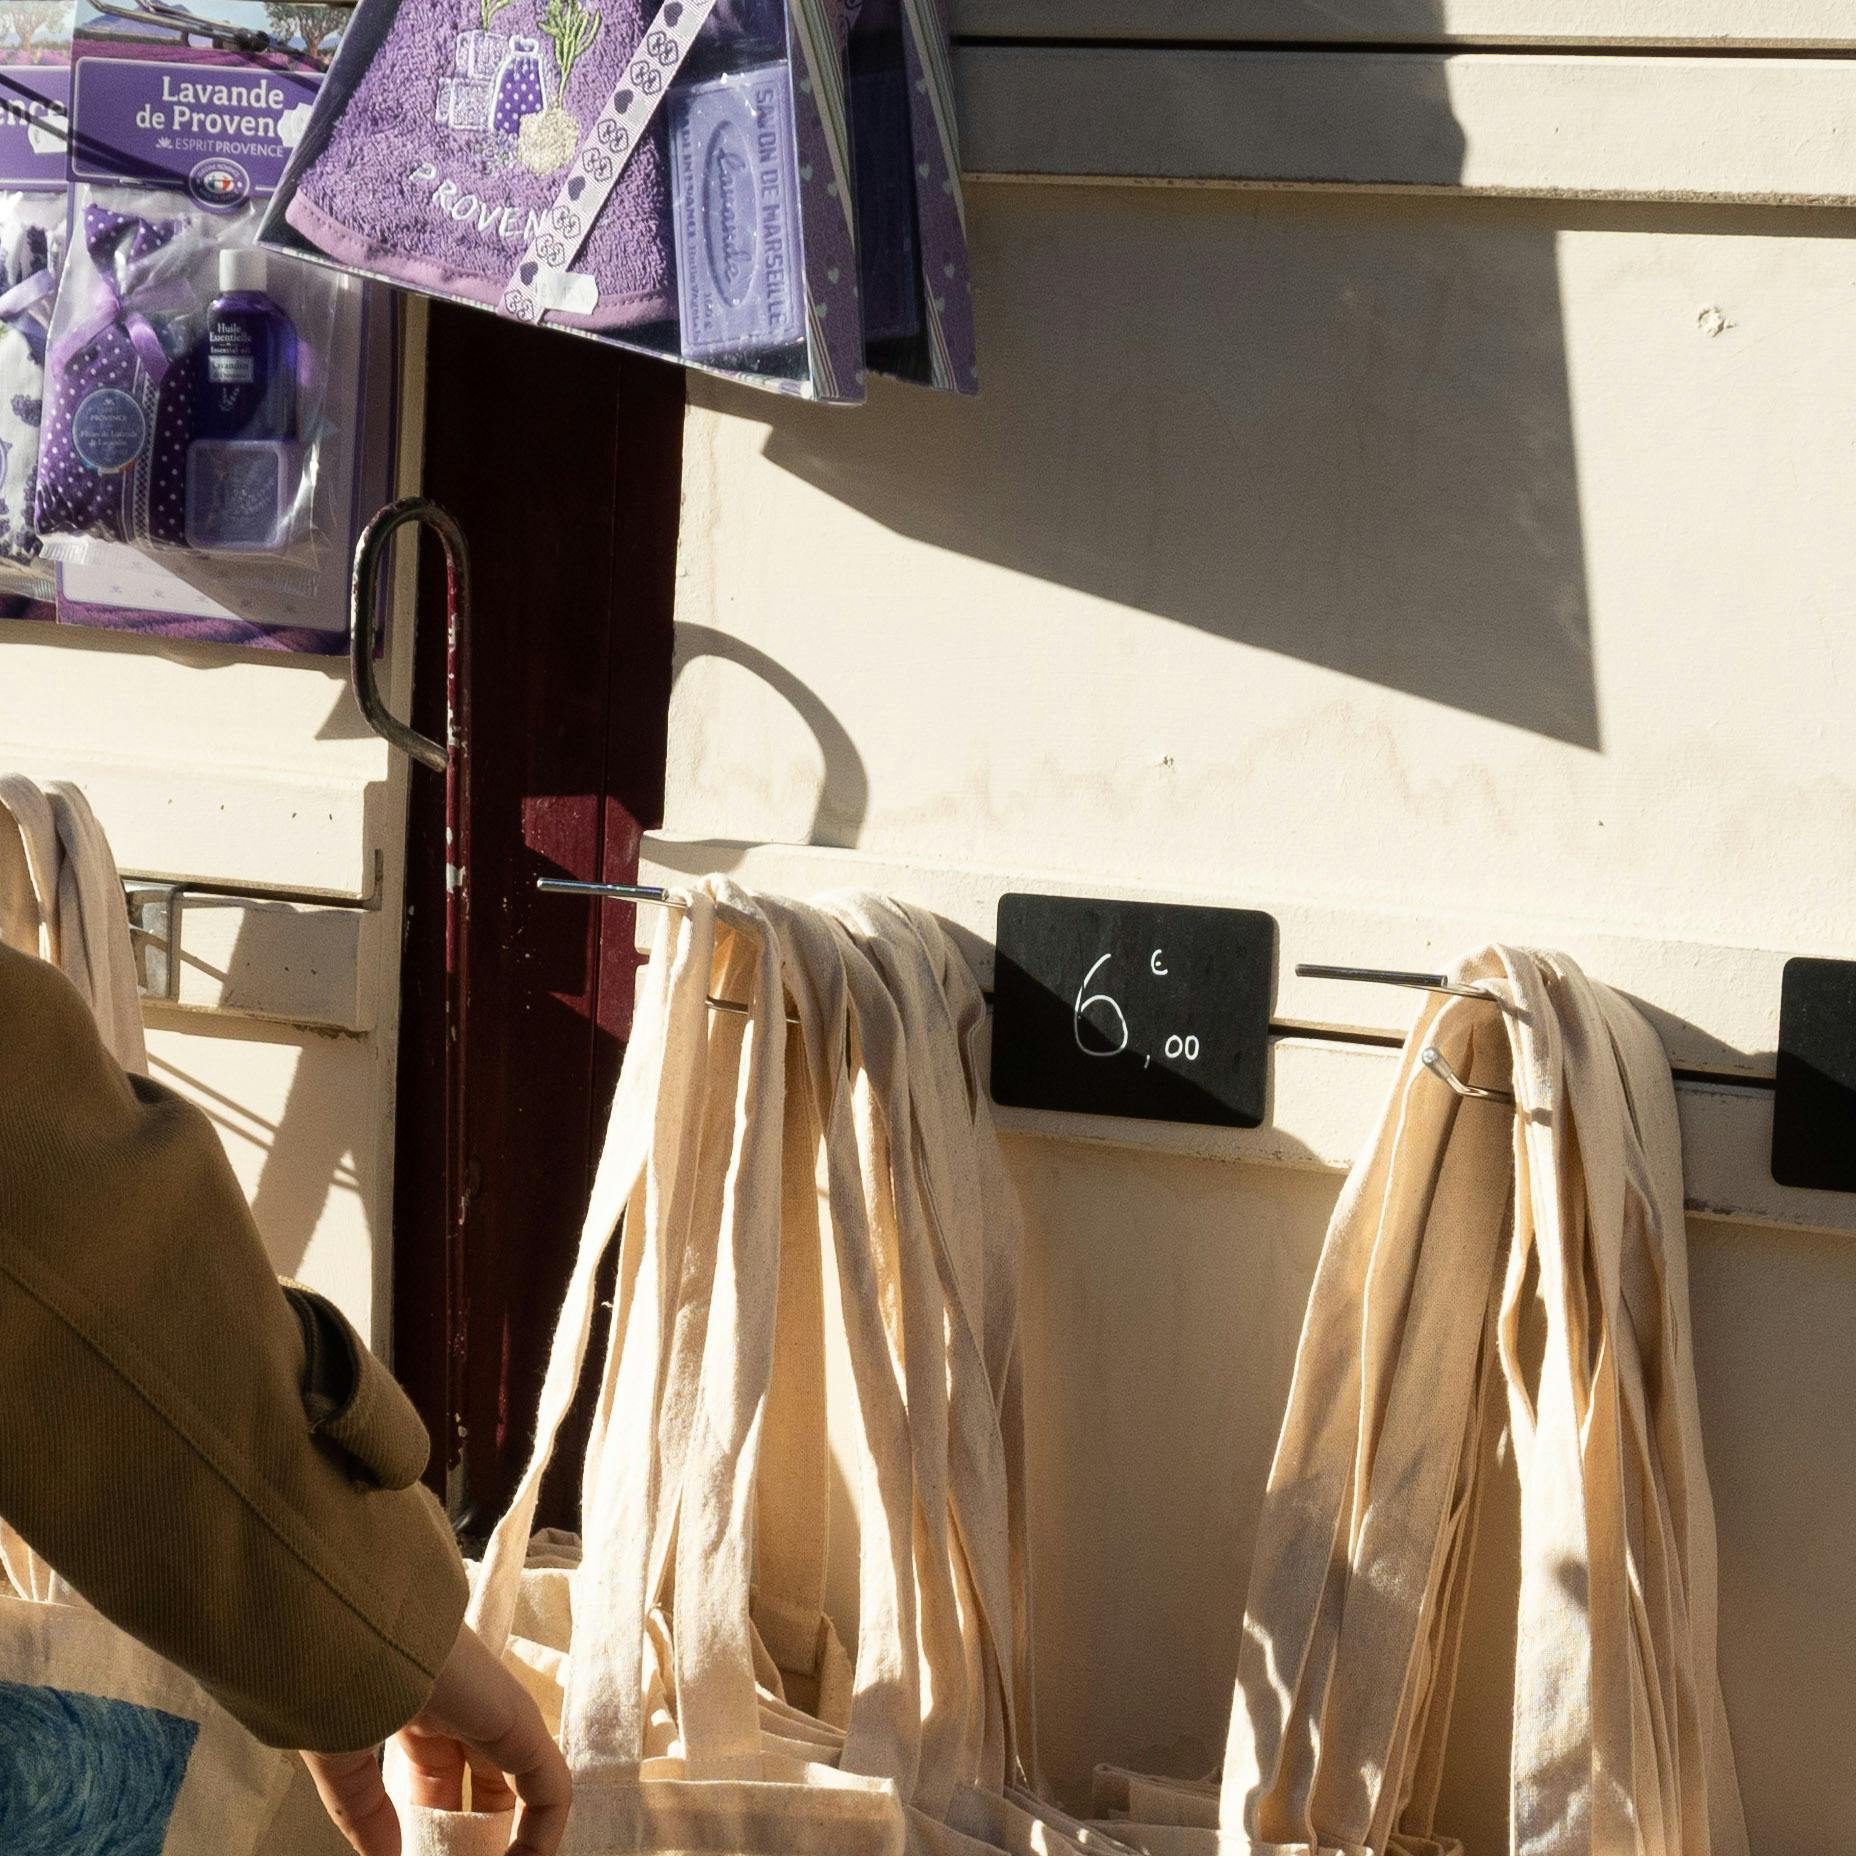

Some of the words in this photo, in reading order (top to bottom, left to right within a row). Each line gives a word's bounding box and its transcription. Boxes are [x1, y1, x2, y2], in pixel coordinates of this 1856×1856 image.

[161, 75, 285, 109] Lavande
[135, 103, 166, 130] de
[172, 105, 279, 138] Proven
[755, 87, 779, 164] SAVON
[409, 162, 545, 240] PROVEN
[760, 168, 781, 199] DE
[761, 203, 787, 328] MARSEILLE
